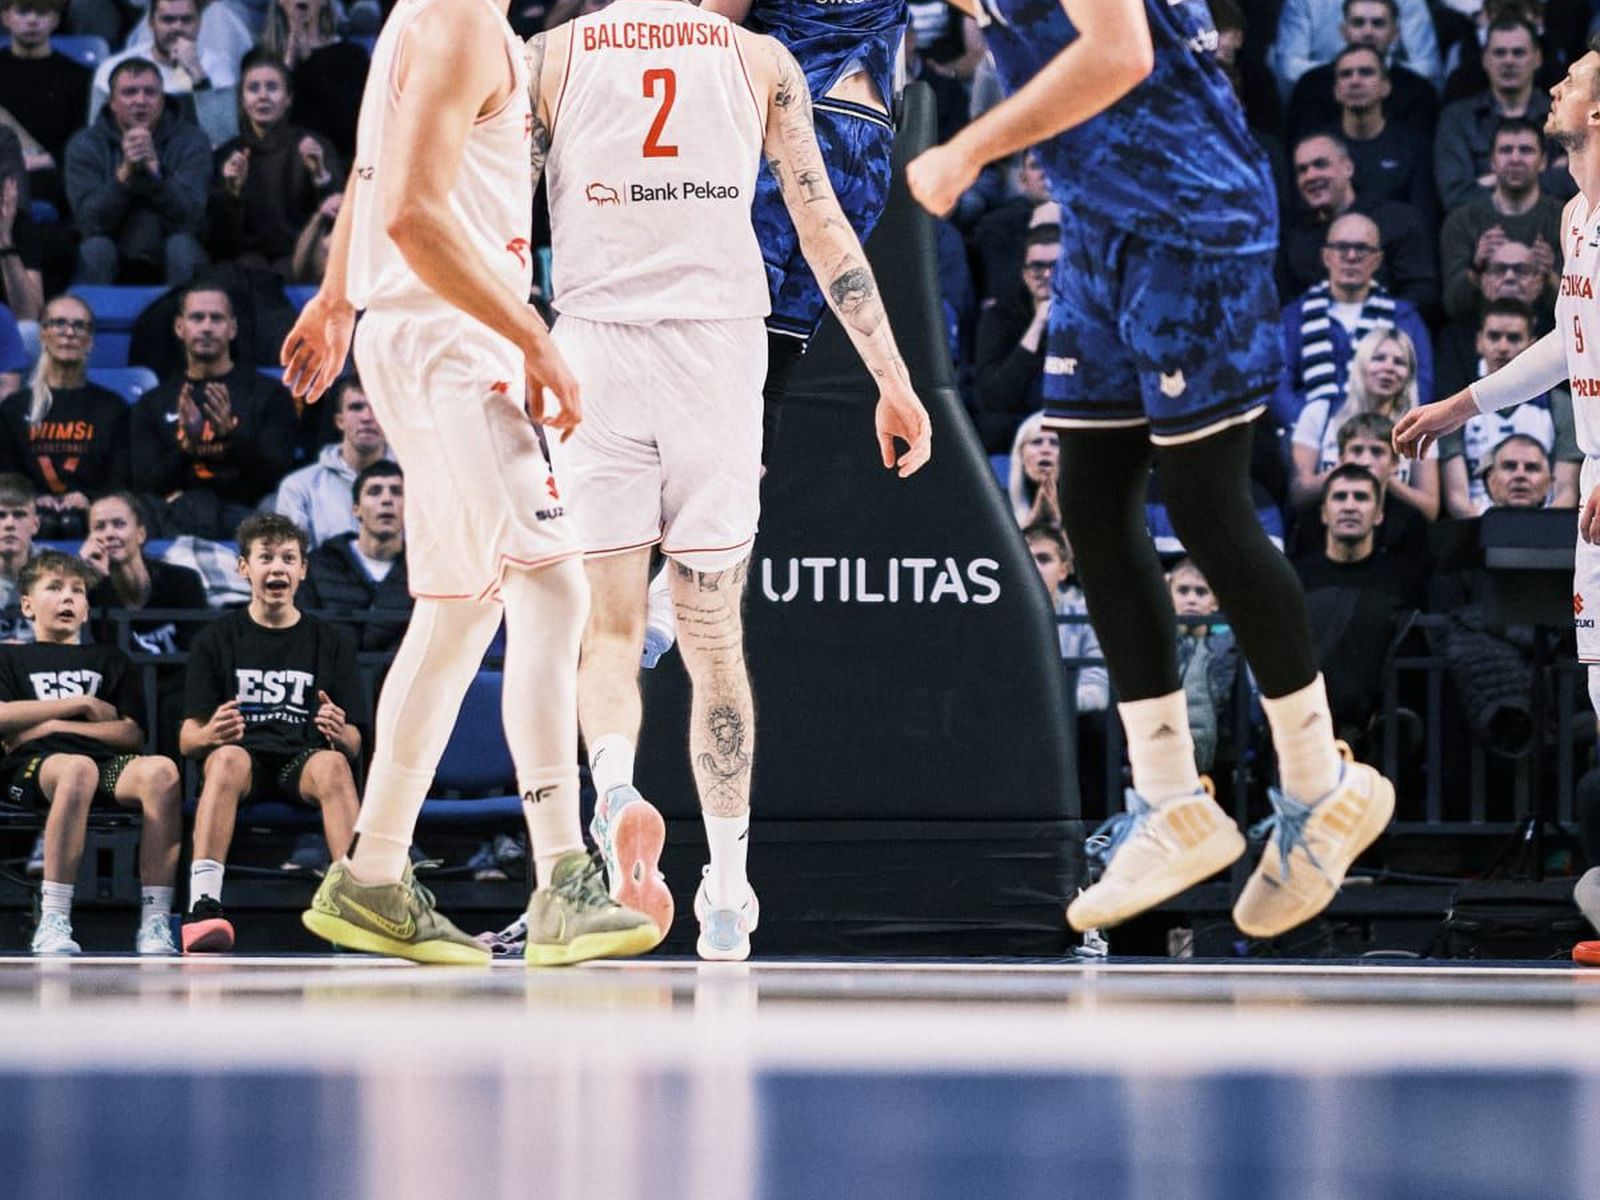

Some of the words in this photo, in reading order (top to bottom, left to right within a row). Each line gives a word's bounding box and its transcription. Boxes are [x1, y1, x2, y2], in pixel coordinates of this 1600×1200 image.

[583, 22, 729, 51] BALCEROWSKI
[642, 67, 679, 158] 2
[631, 182, 678, 202] Bank
[683, 182, 740, 201] Pekao
[762, 557, 1000, 603] UTILITAS
[235, 668, 314, 705] EST
